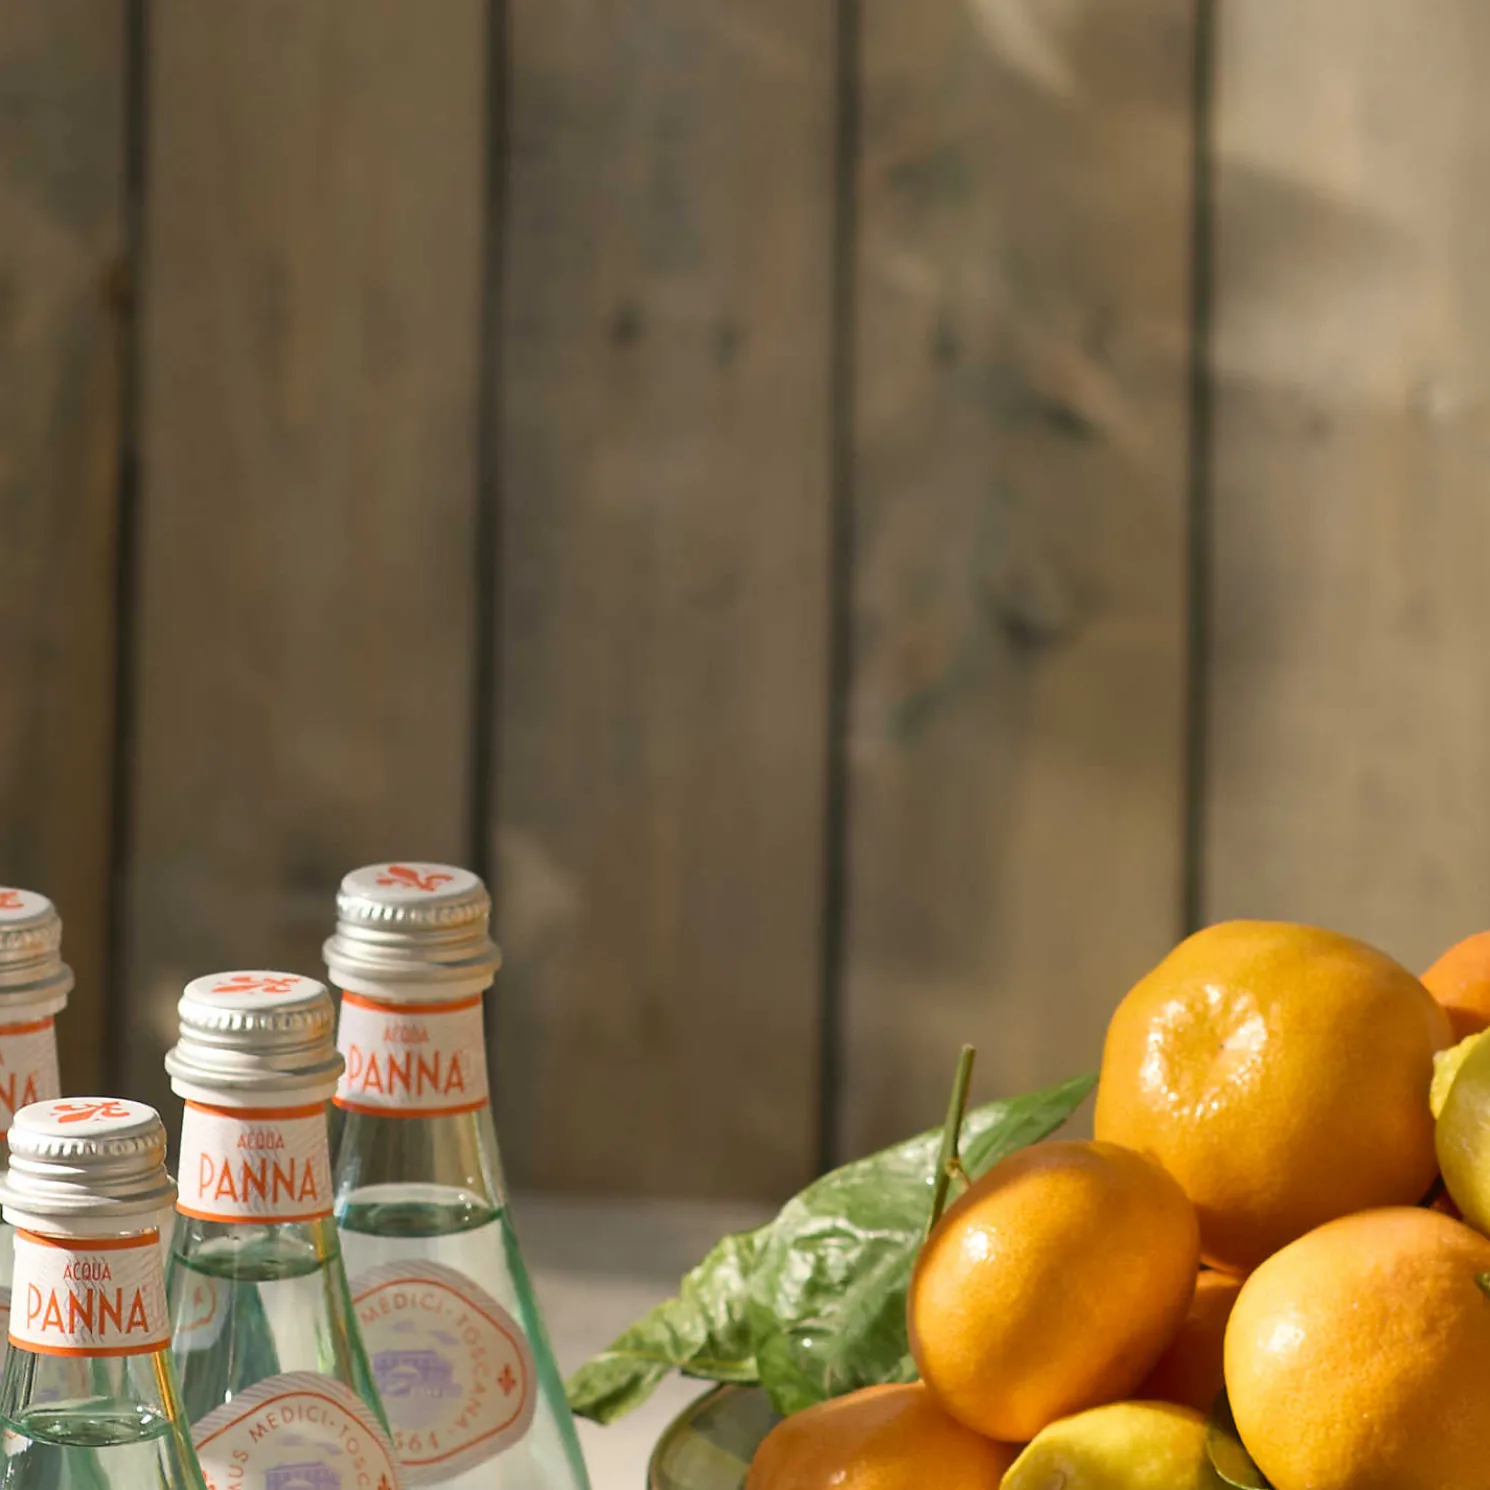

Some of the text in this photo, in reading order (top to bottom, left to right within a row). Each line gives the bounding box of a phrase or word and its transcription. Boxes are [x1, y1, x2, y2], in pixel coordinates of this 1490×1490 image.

[348, 1044, 465, 1097] PANNA
[236, 1130, 285, 1150] ACQUA
[198, 1151, 318, 1204] PANNA
[63, 1259, 112, 1281] ACQUA
[27, 1281, 149, 1335] PANNA
[360, 1291, 491, 1430] MEDICI TOSCANA
[248, 1403, 328, 1444] MEDICI
[394, 1430, 440, 1453] 564
